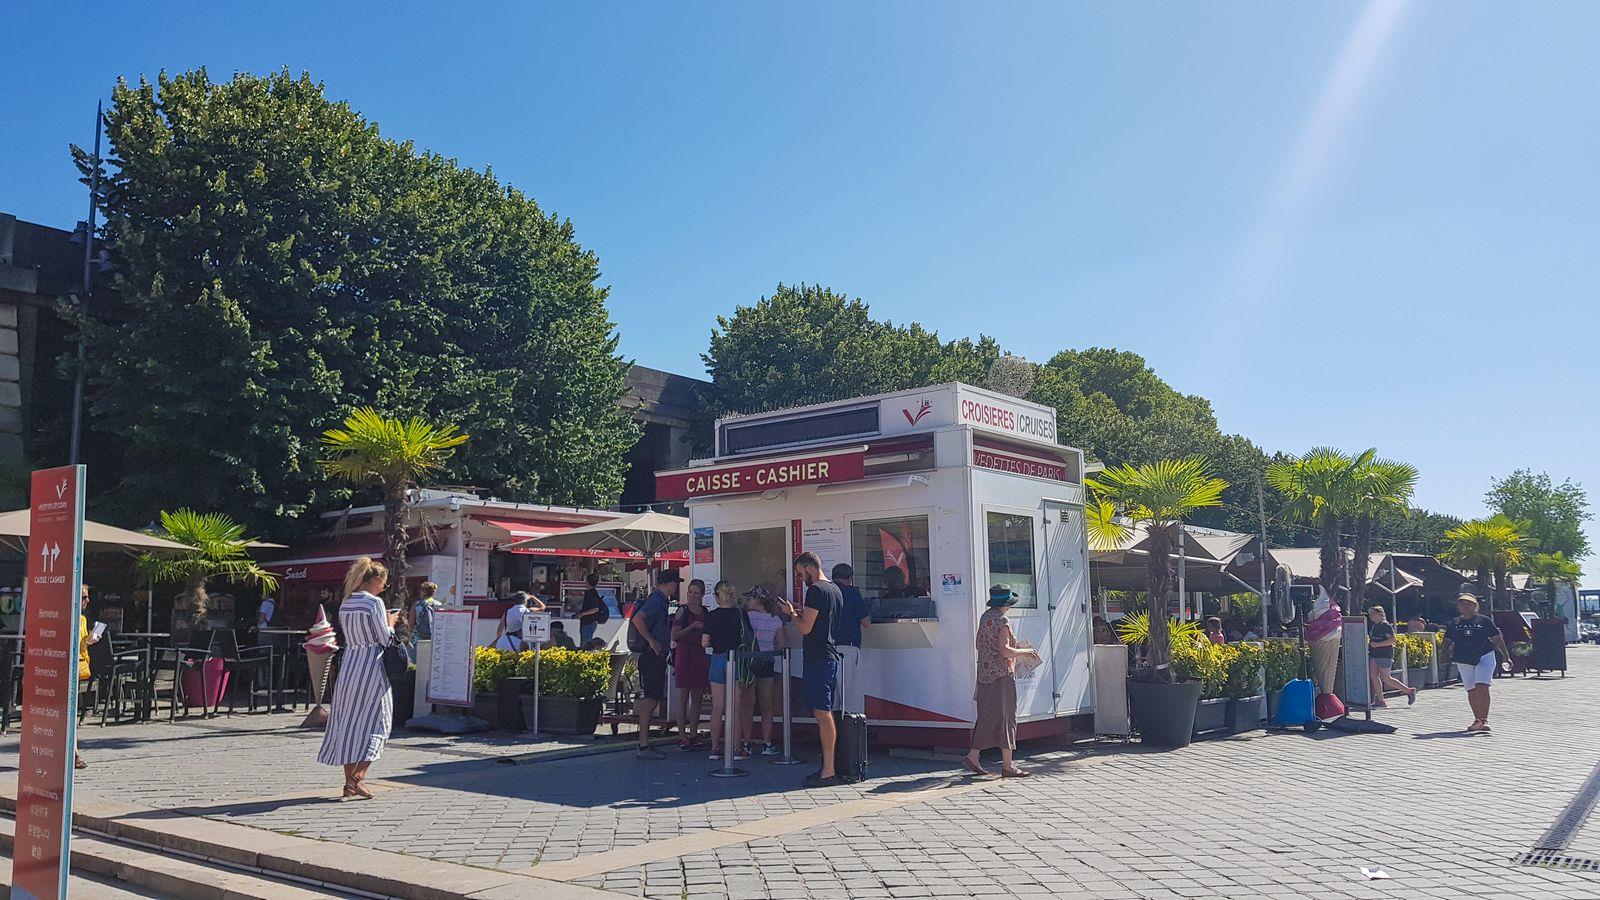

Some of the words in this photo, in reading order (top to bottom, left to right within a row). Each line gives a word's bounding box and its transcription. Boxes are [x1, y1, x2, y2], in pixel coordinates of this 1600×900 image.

[962, 399, 1015, 431] CROISIERES
[686, 471, 740, 493] CAISSE
[756, 461, 829, 484] CASHIER
[974, 453, 1021, 474] VEDETTES
[1023, 463, 1035, 476] DE
[1037, 466, 1060, 480] PARIS
[50, 575, 66, 583] CASHIER
[284, 567, 307, 580] Snack
